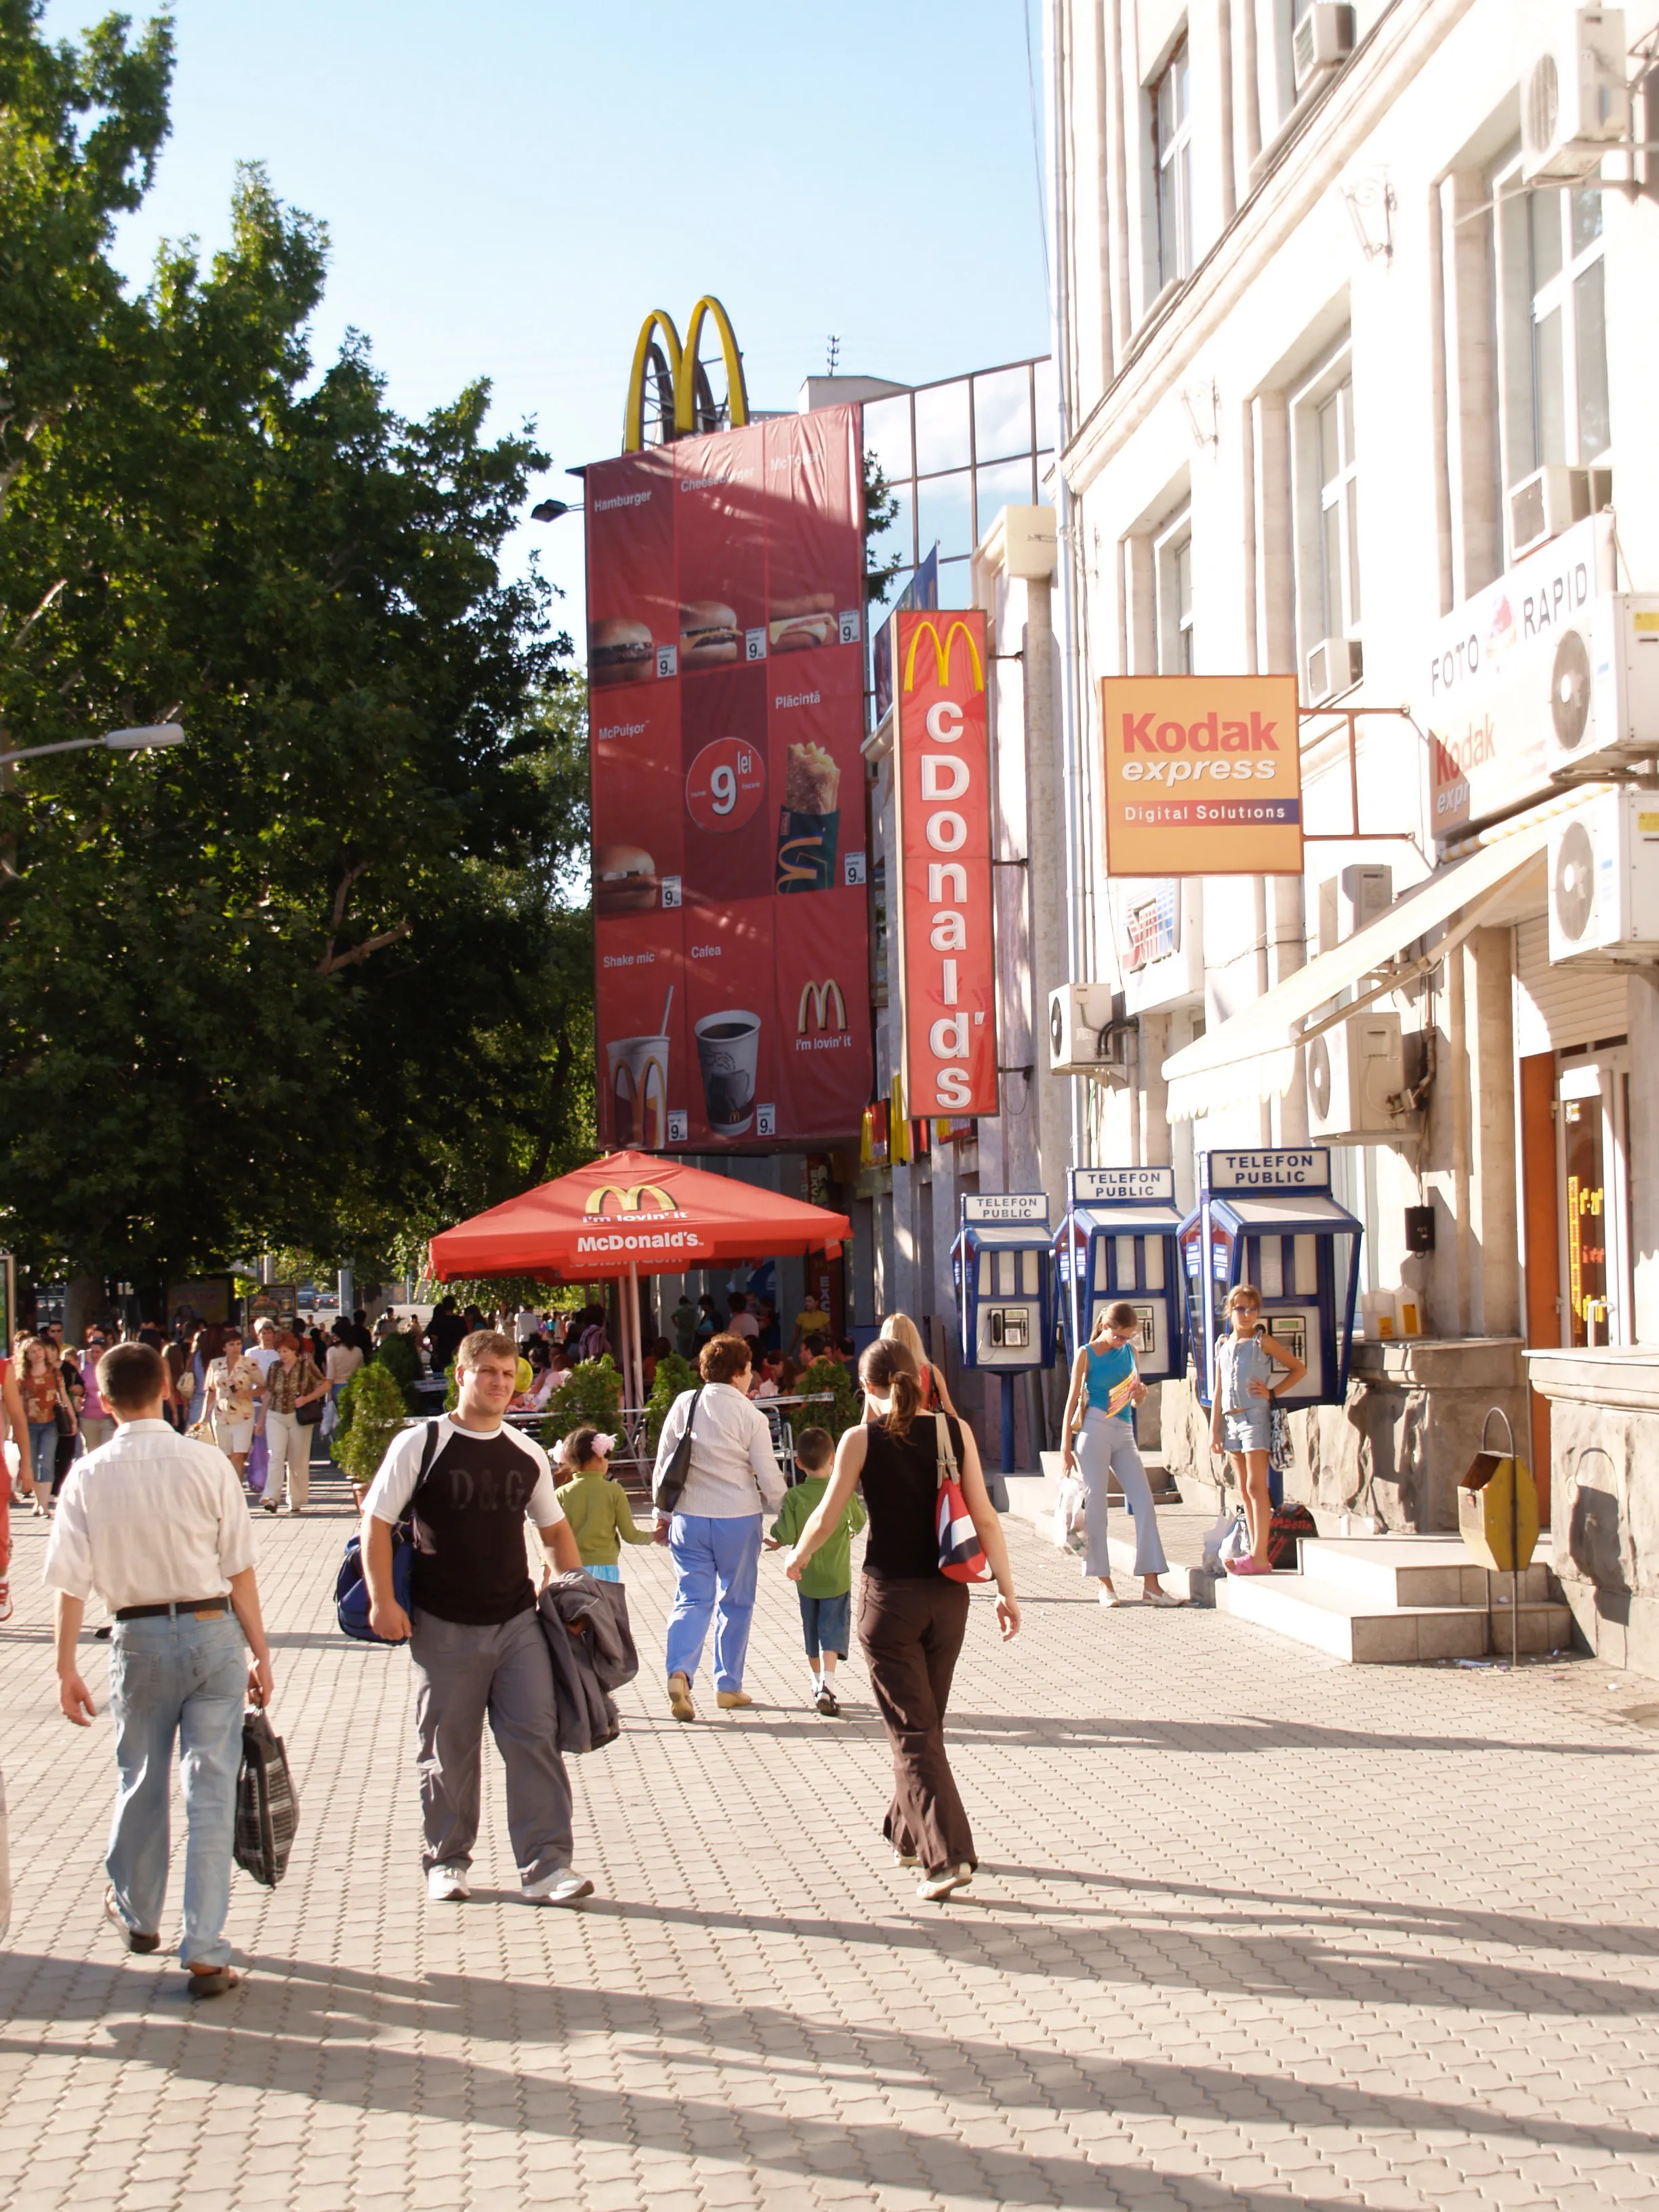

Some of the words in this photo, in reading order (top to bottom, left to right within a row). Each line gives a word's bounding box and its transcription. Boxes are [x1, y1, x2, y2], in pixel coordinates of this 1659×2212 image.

[594, 490, 653, 513] Hamburger
[1431, 634, 1479, 697] FOTO
[1523, 562, 1588, 640] RAPID
[1122, 712, 1280, 754] Kodak
[1435, 713, 1495, 787] Kodak
[1122, 759, 1277, 787] express
[710, 764, 737, 815] 9
[737, 749, 752, 775] lei
[1125, 806, 1188, 823] Digital
[602, 954, 634, 968] Shake
[636, 951, 655, 964] mic
[691, 945, 722, 958] Cafea
[796, 1038, 812, 1051] i'm
[813, 1035, 842, 1050] lovin'
[843, 1034, 852, 1048] it
[1229, 1155, 1313, 1168] TELEFON
[1088, 1173, 1161, 1185] TELEFON
[1235, 1170, 1306, 1184] PUBLIC
[1095, 1186, 1154, 1197] PUBLIC
[977, 1198, 1038, 1207] TELEFON
[617, 1212, 670, 1222] lovin'
[673, 1210, 690, 1219] it
[983, 1209, 1031, 1218] PUBLIC
[577, 1231, 699, 1253] McDonald's
